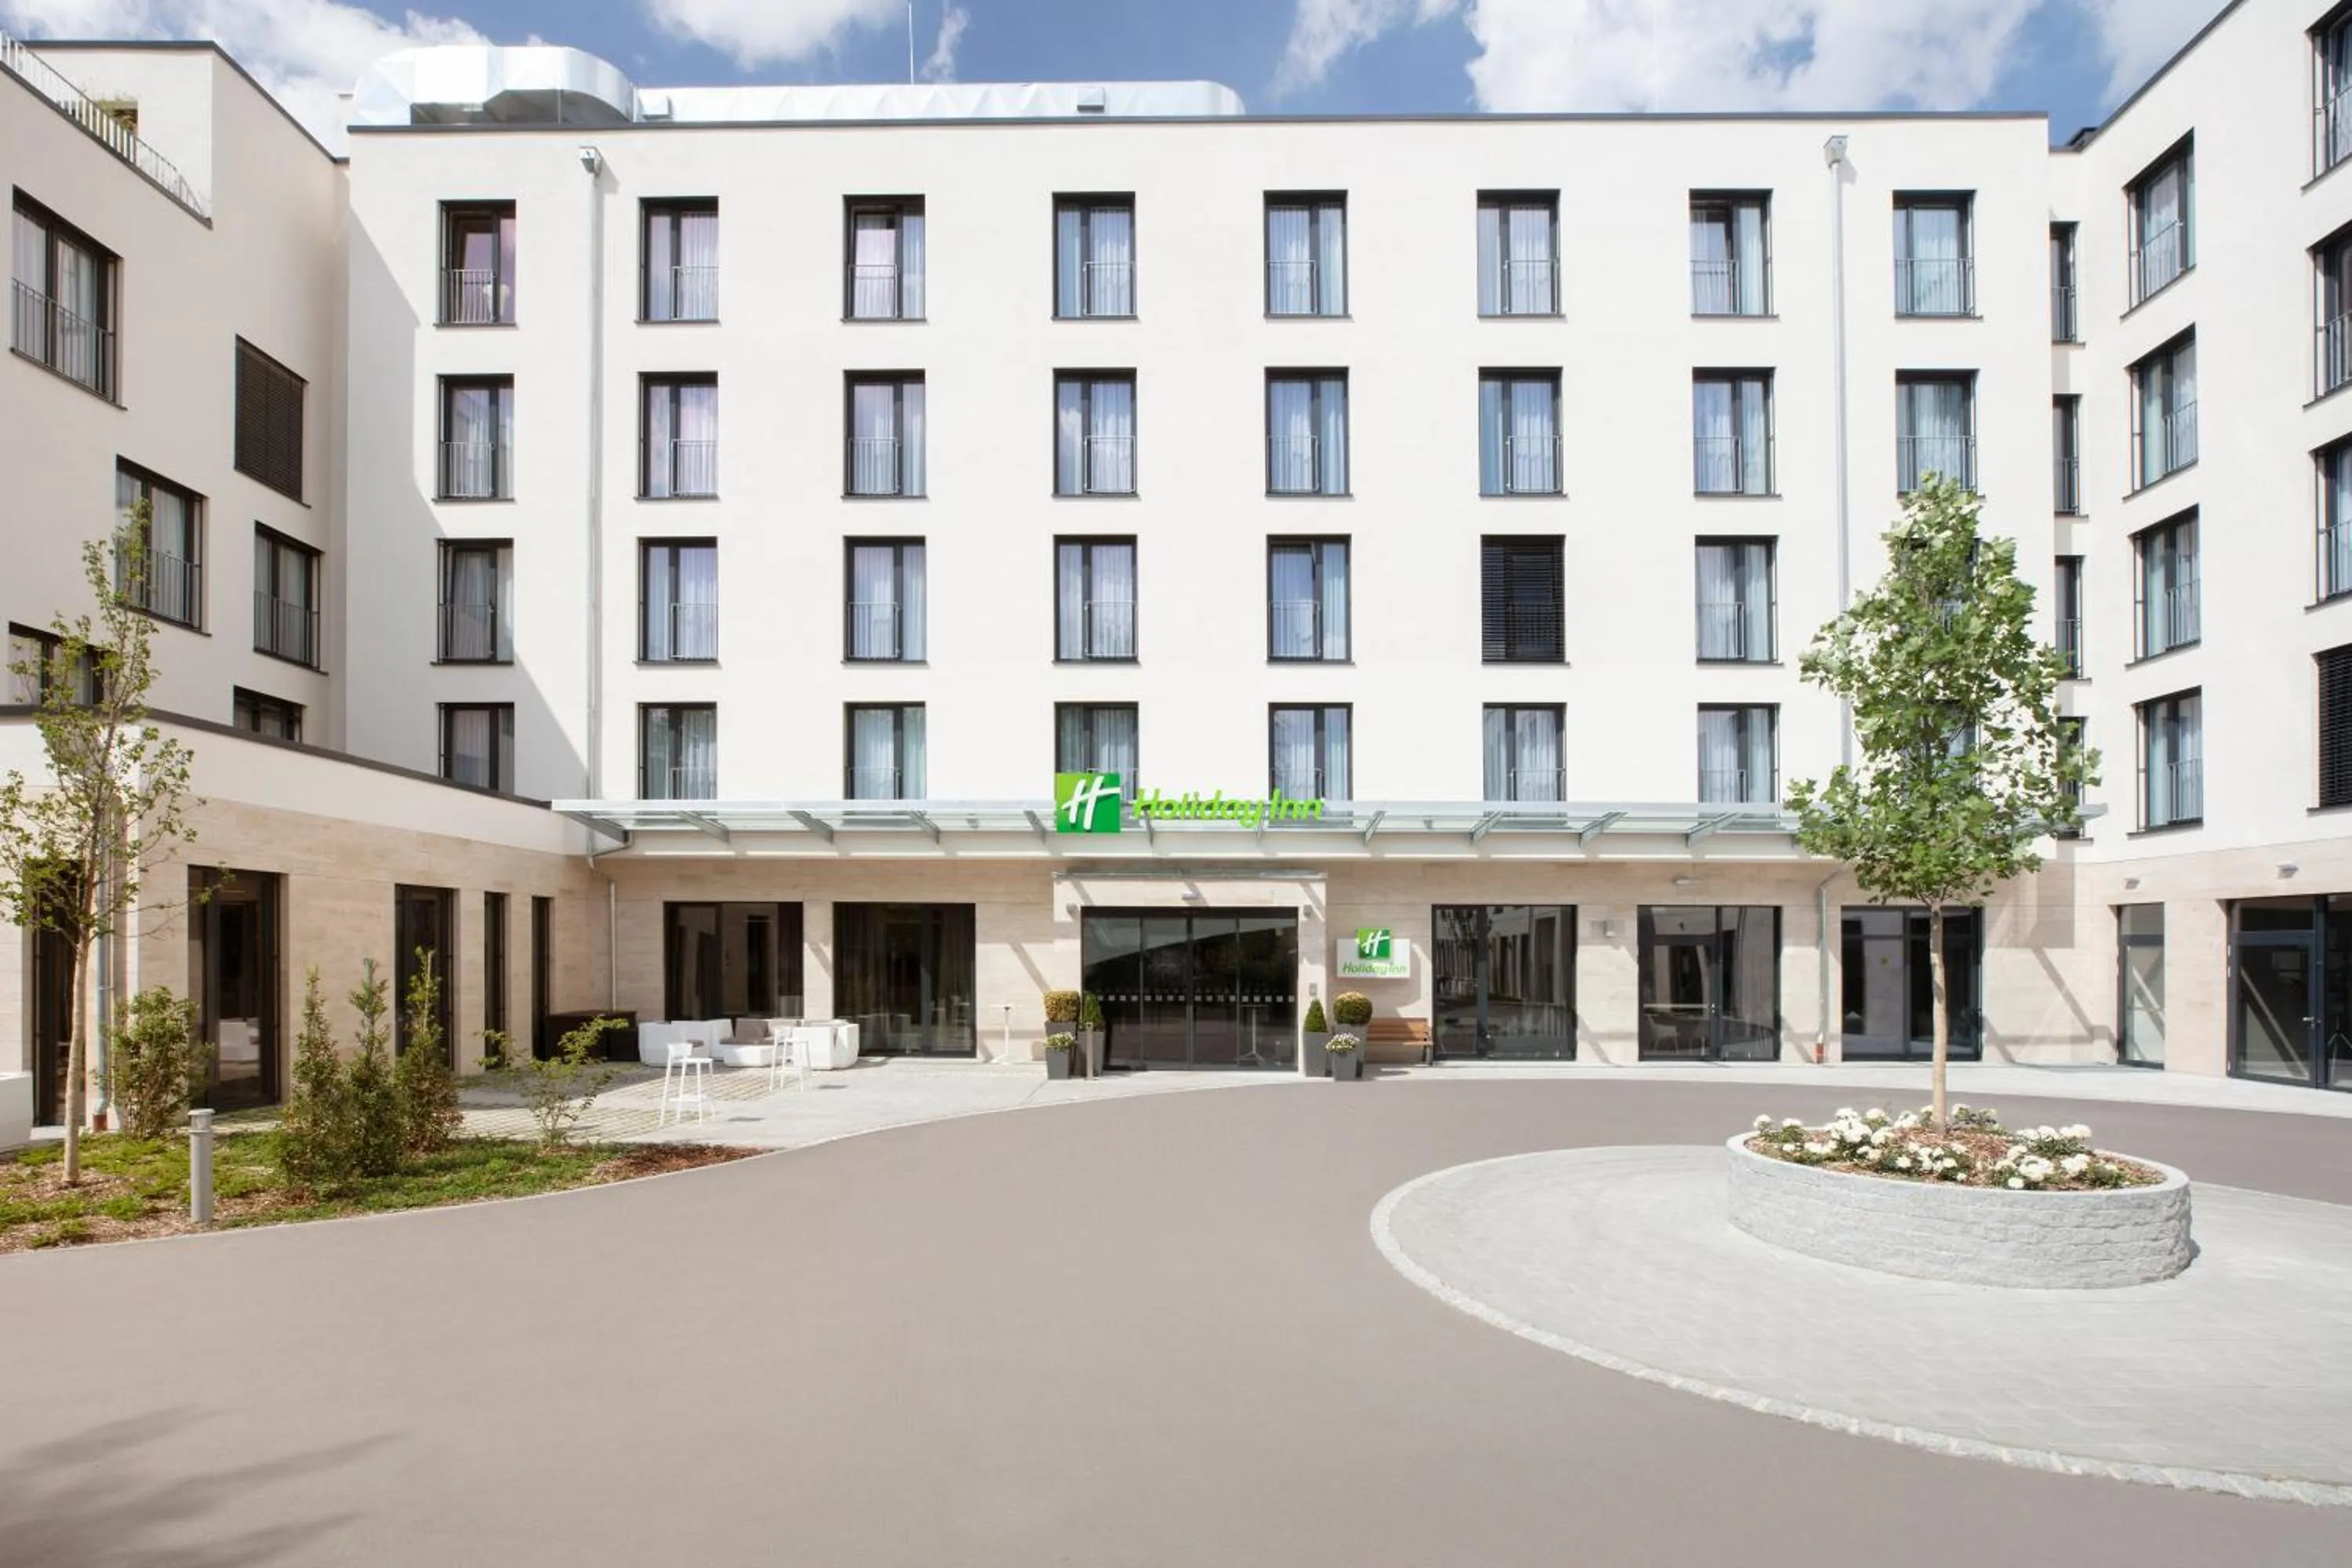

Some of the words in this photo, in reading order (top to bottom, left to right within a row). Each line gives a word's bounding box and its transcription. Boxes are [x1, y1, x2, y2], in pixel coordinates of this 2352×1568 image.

[1062, 775, 1121, 830] H
[1134, 788, 1264, 829] Holiday
[1269, 788, 1325, 821] Inn
[1361, 931, 1390, 956] H
[1342, 961, 1387, 975] Holiday
[1388, 962, 1406, 973] Inn
